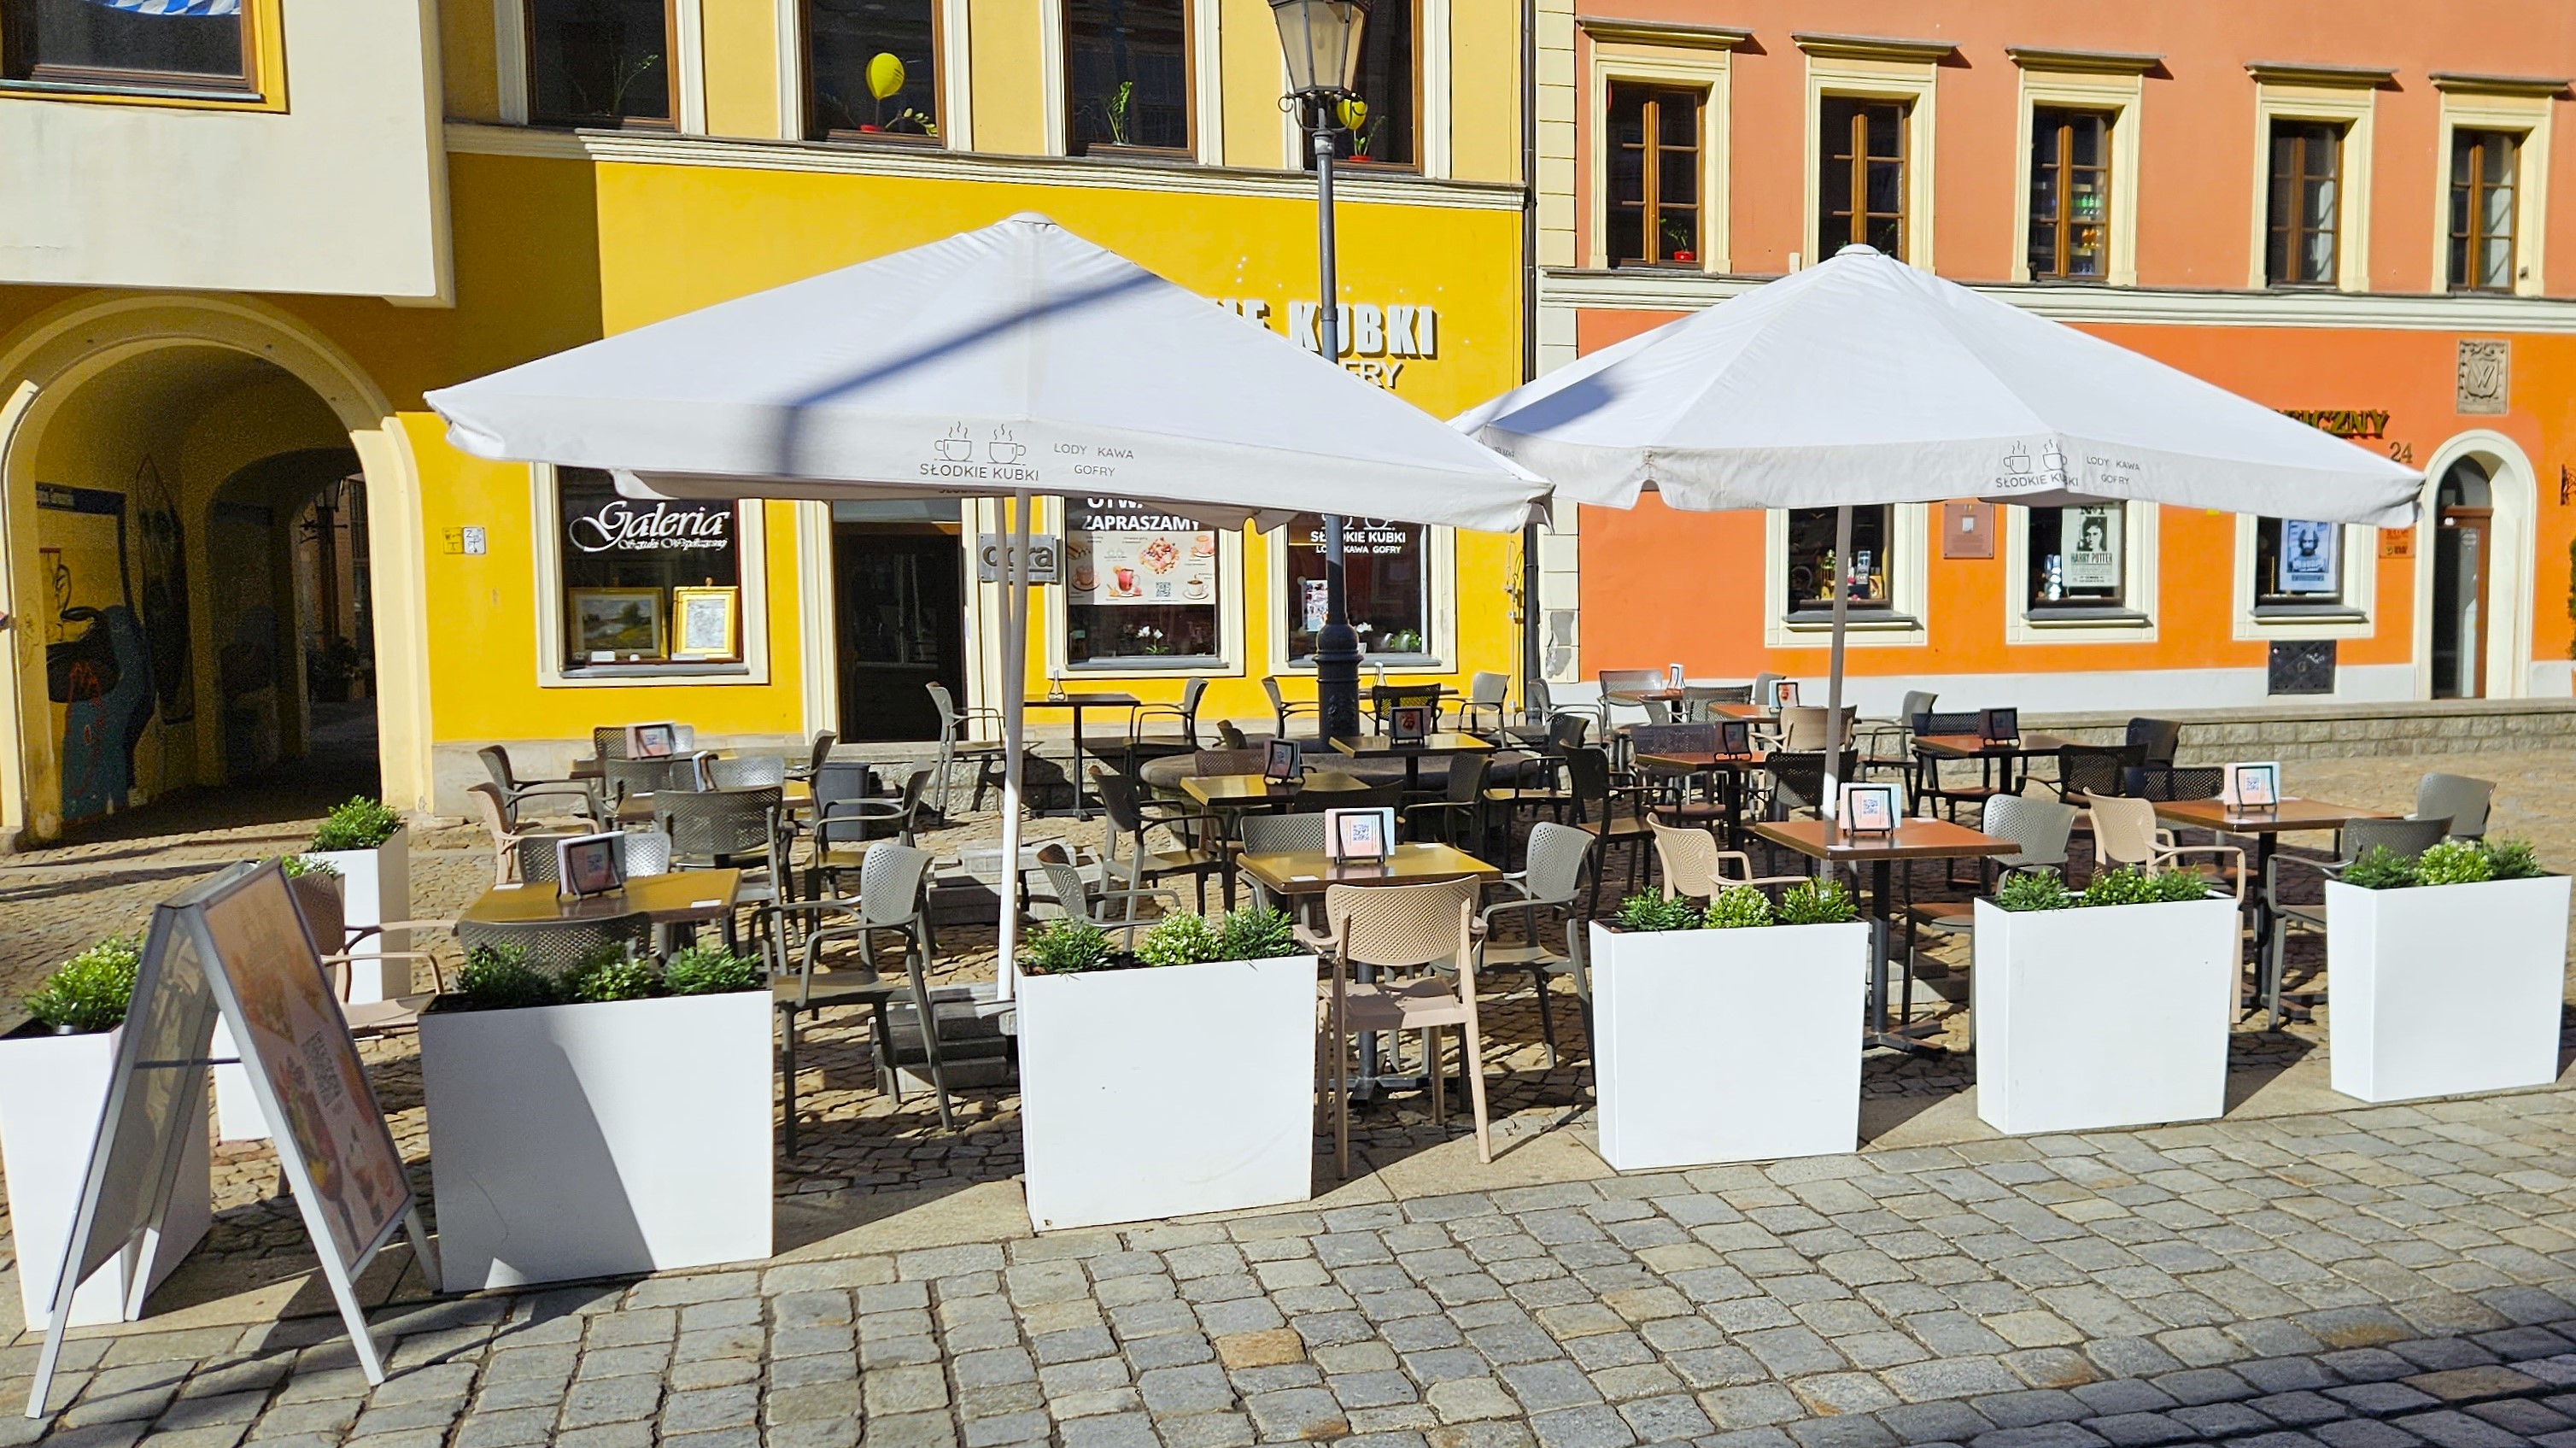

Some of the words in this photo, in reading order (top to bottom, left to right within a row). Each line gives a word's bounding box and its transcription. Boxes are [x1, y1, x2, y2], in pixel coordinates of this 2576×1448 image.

[1054, 443, 1087, 454] LODY
[1098, 447, 1134, 460] KAWA
[2390, 442, 2413, 463] 24
[2087, 455, 2110, 466] LODY
[2116, 460, 2140, 471] KAWA
[920, 463, 987, 478] SŁODKIE
[992, 467, 1039, 481] KUBKI
[1074, 464, 1115, 477] GOFRY
[1995, 475, 2047, 488] SŁODKIE
[2101, 474, 2130, 484] GOFRY
[569, 501, 730, 552] Galeria
[1310, 531, 1366, 542] SŁKIE
[1368, 531, 1406, 542] KUBKI
[1372, 545, 1402, 554] GOFRY
